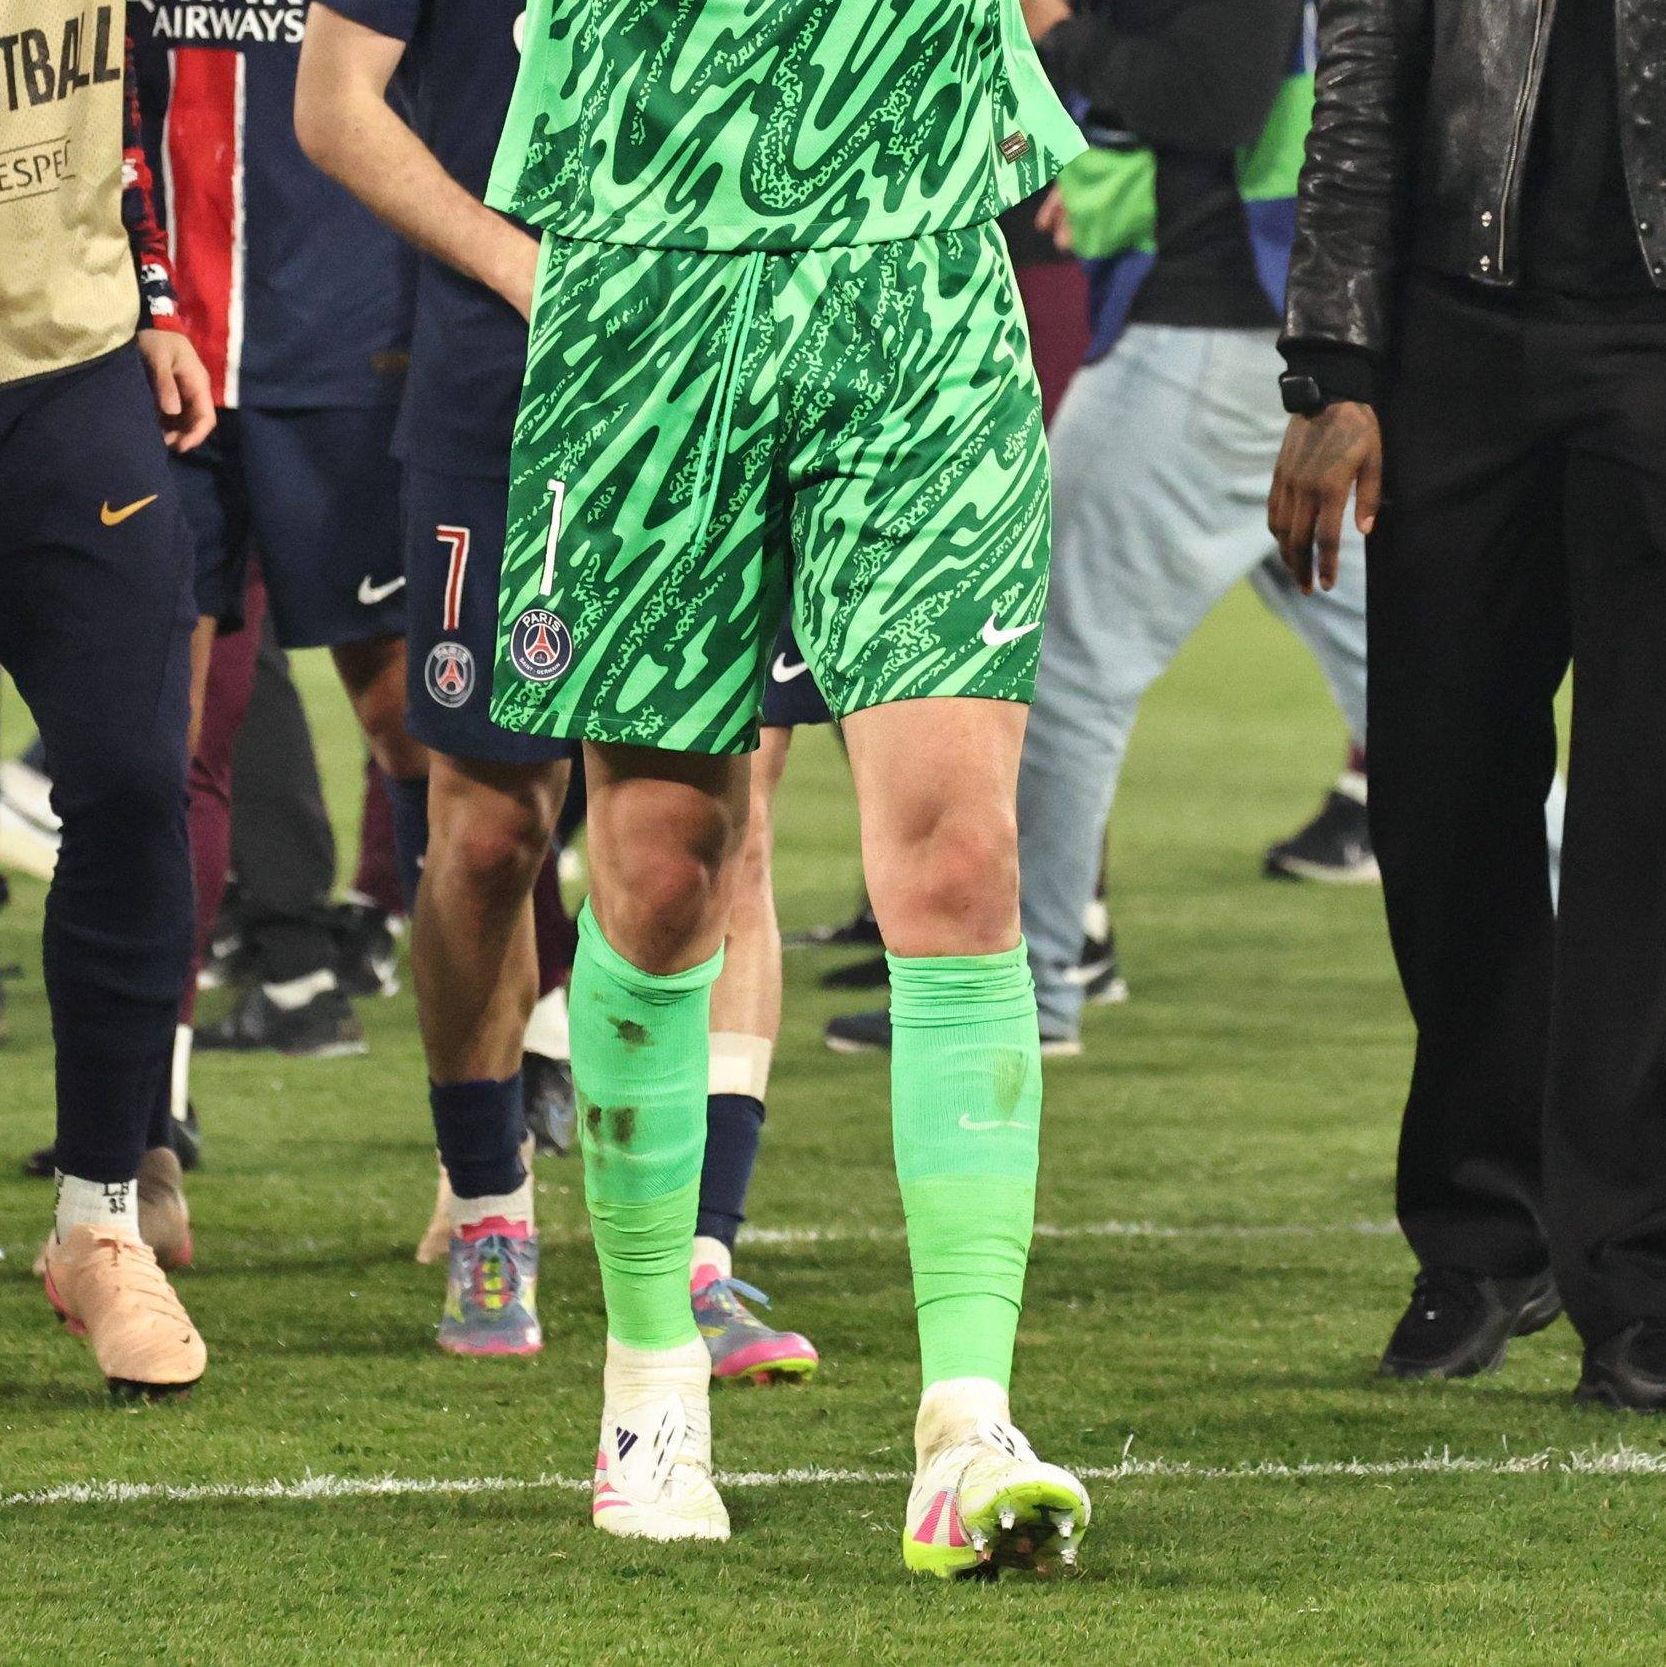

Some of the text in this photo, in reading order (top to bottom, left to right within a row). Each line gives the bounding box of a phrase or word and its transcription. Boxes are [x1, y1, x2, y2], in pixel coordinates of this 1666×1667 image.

[152, 4, 306, 44] AIRWAYS
[539, 479, 565, 596] 1
[436, 525, 471, 631] 7
[522, 613, 562, 632] PARIS
